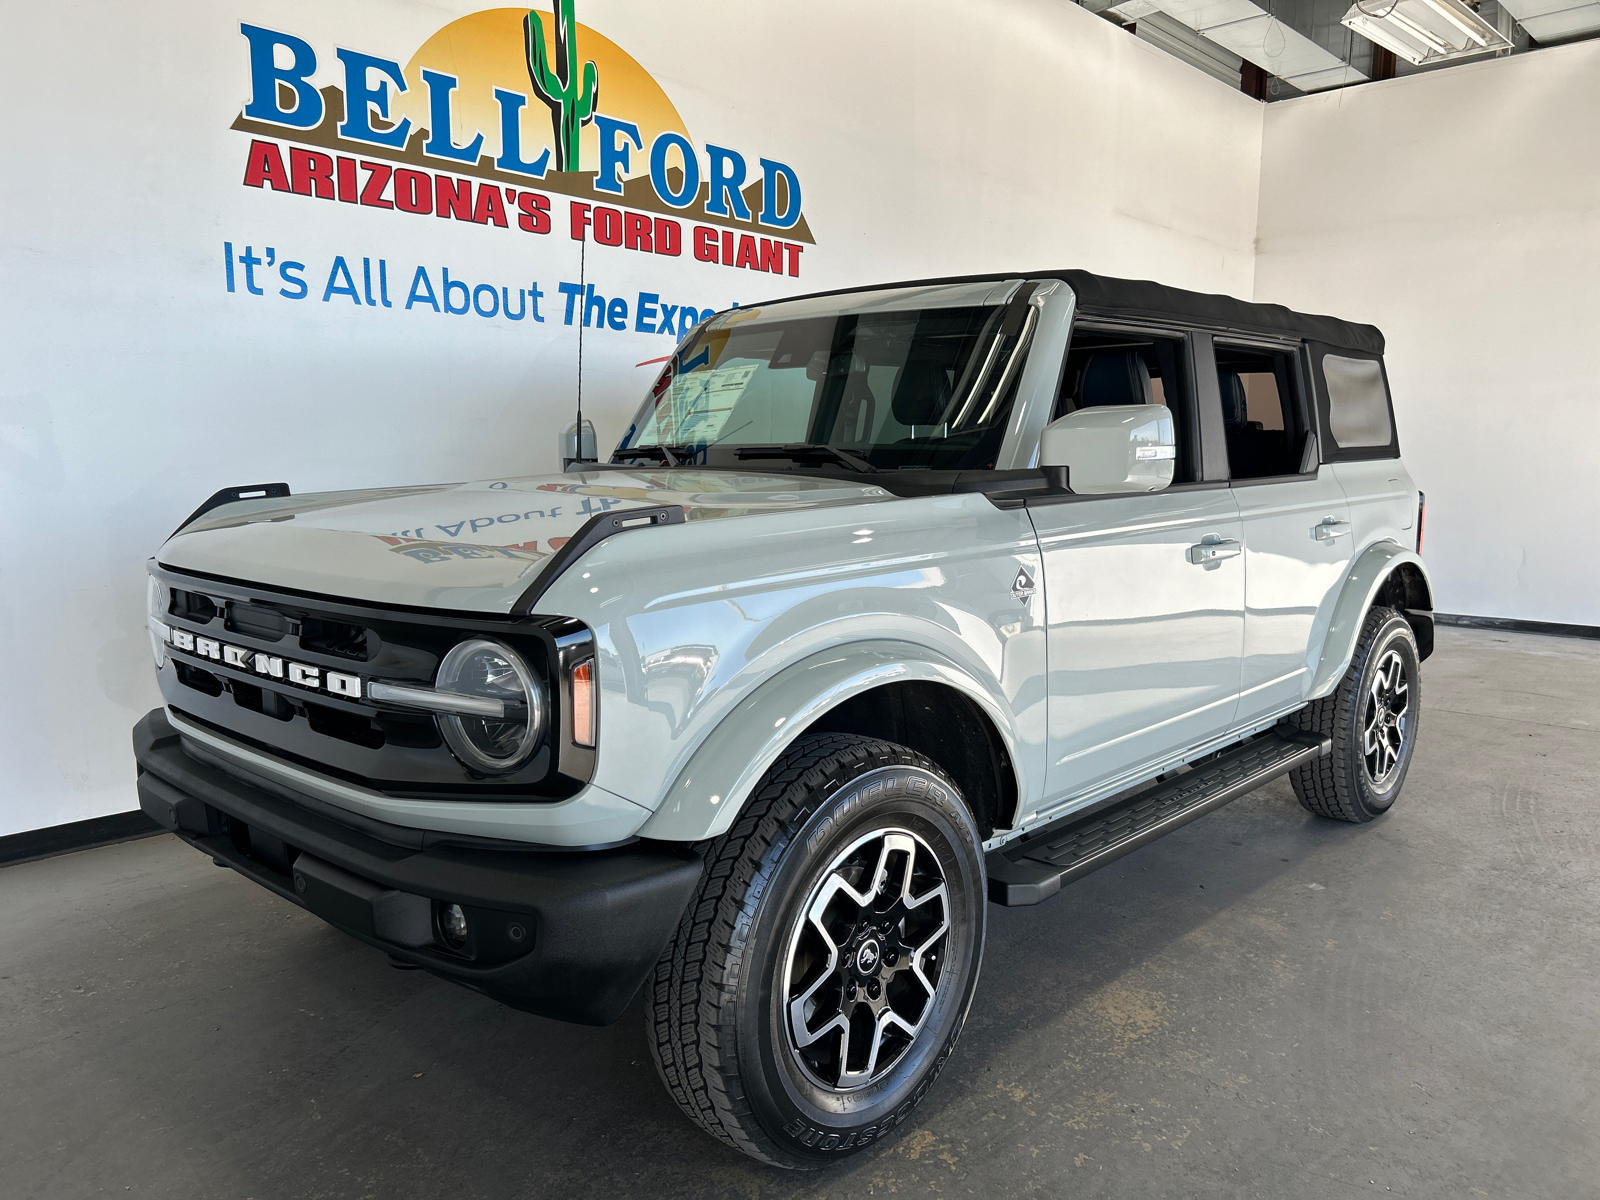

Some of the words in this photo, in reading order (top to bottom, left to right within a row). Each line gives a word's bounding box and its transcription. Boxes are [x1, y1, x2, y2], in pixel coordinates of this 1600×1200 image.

[240, 22, 551, 178] BELL
[594, 114, 803, 229] FORD
[243, 138, 552, 235] ARIZONA'S
[570, 201, 682, 257] FORD
[693, 225, 804, 278] GIANT
[223, 241, 308, 301] It's
[322, 256, 392, 309] All
[405, 266, 545, 325] About
[558, 281, 629, 332] The
[173, 628, 362, 698] BRONCO
[806, 775, 948, 857] DUELER
